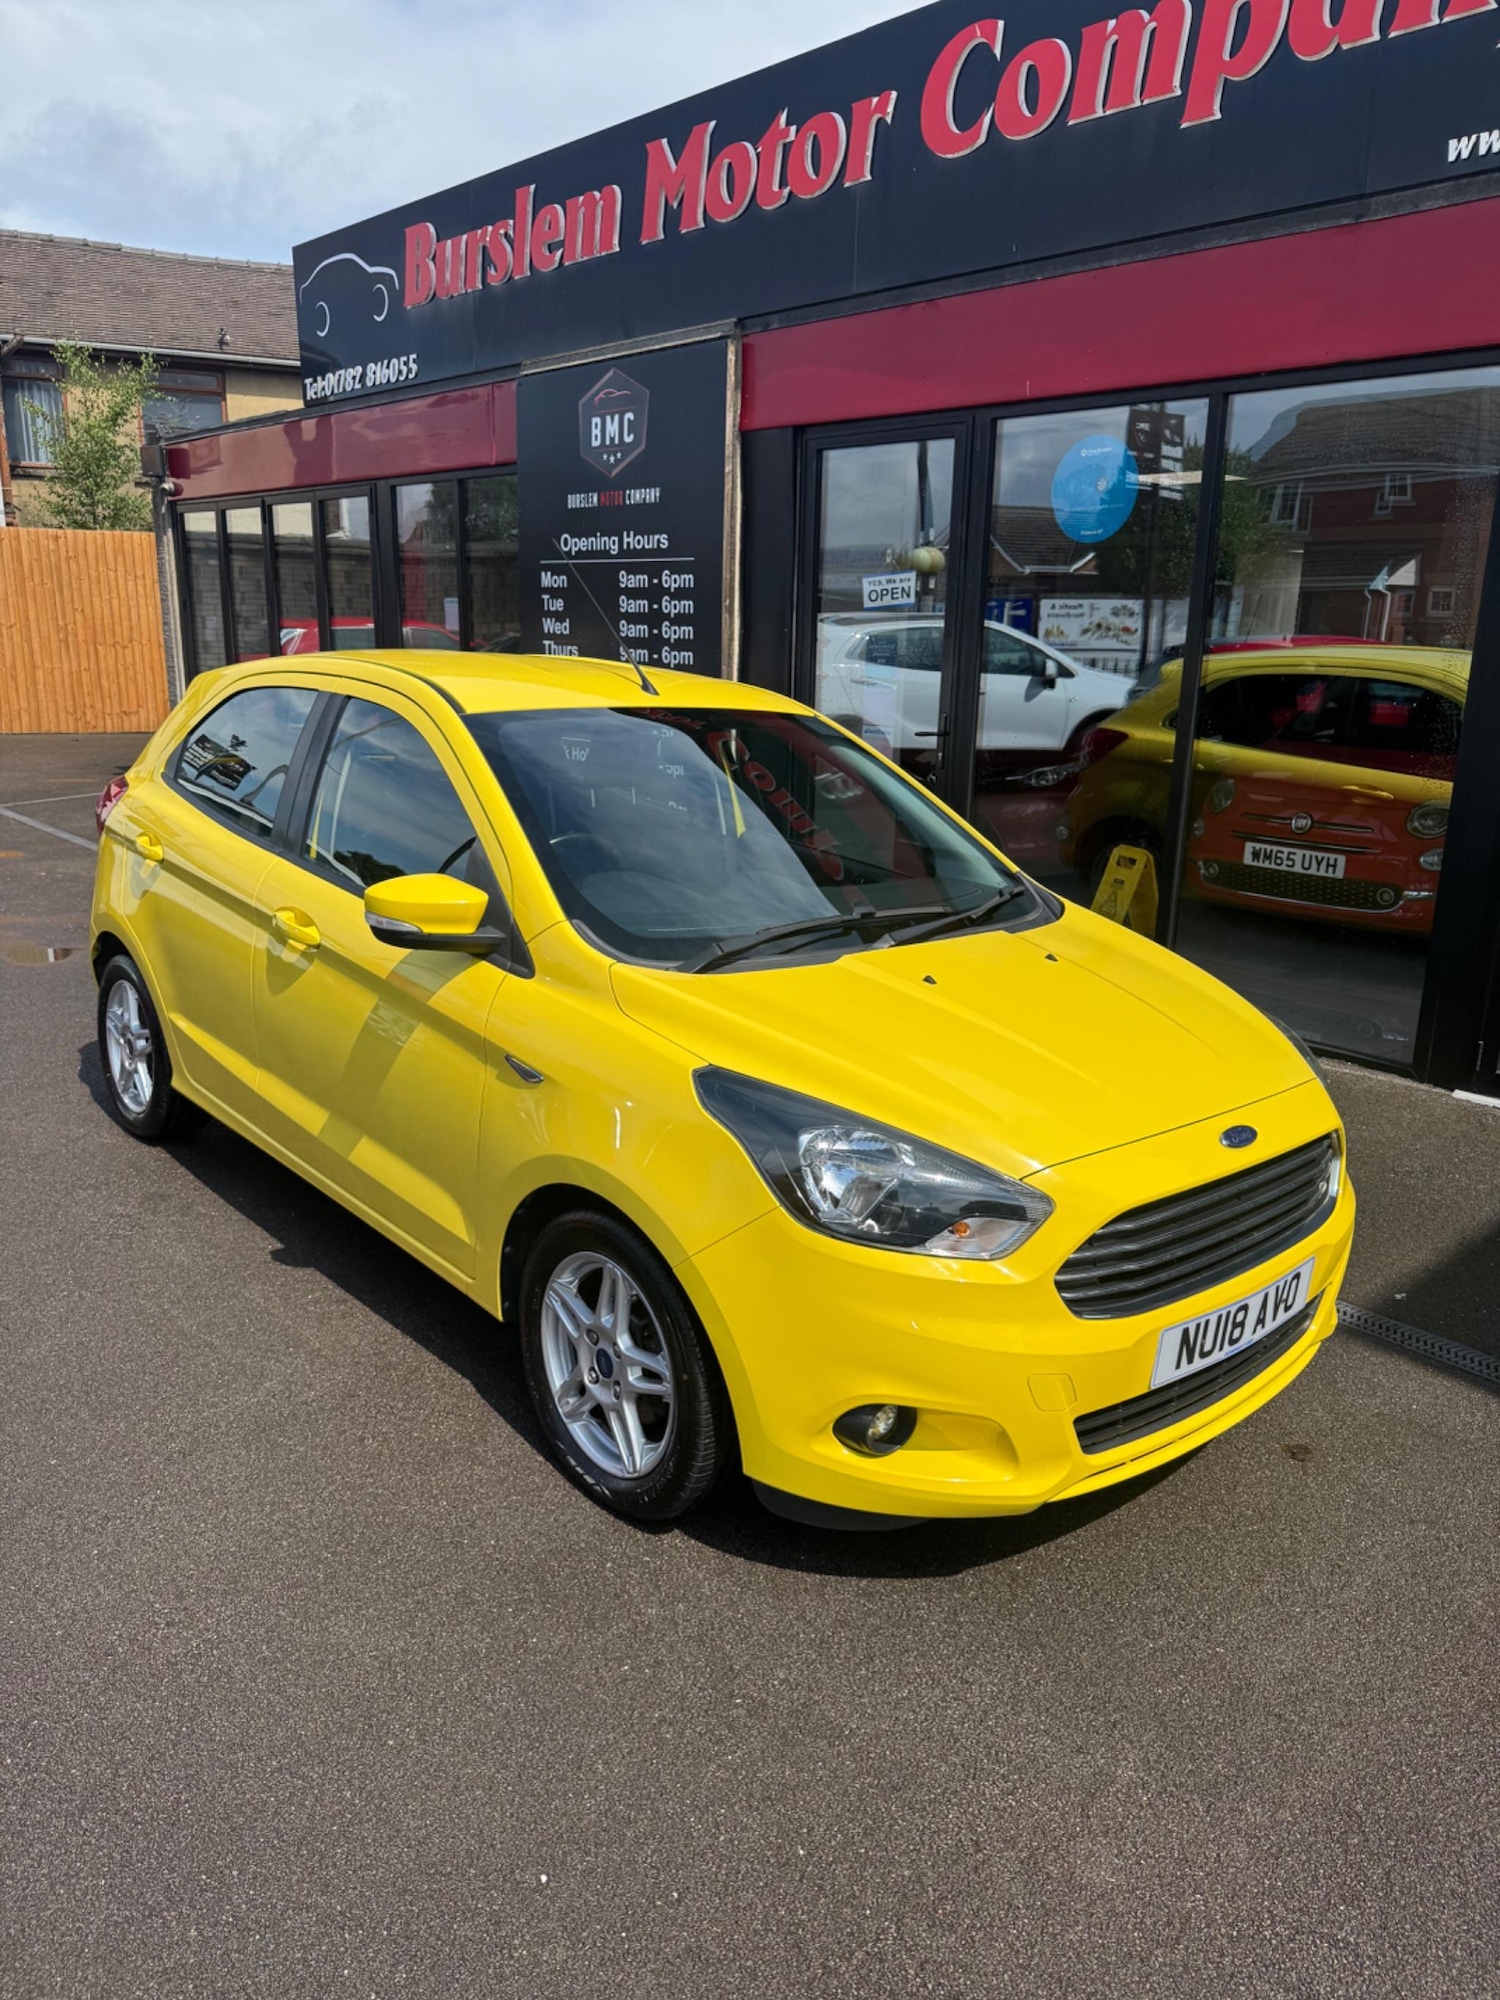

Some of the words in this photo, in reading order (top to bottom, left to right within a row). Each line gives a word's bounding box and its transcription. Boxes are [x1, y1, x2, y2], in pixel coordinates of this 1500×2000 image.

[403, 183, 622, 310] Burslem
[639, 90, 898, 245] Motor
[365, 353, 418, 388] 816055
[590, 411, 634, 447] BMC
[567, 491, 598, 509] BURSLEM
[625, 486, 660, 505] COMPANY
[560, 532, 618, 555] Opening
[623, 530, 669, 550] Hours
[540, 572, 567, 588] Mon
[618, 570, 648, 588] 9am
[661, 570, 694, 592] 6pm
[542, 595, 564, 611] Tue
[618, 596, 648, 613] 9am
[661, 595, 694, 618] 6pm
[868, 586, 911, 603] OPEN
[542, 618, 570, 635] Wed
[618, 621, 648, 638] 9am
[661, 620, 694, 643] 6pm
[543, 640, 579, 657] Thurs
[661, 646, 694, 668] 6pm
[1251, 845, 1297, 868] WM65
[1301, 853, 1338, 875] UYH
[1175, 1303, 1249, 1370] NU18
[1252, 1271, 1301, 1336] AVO
